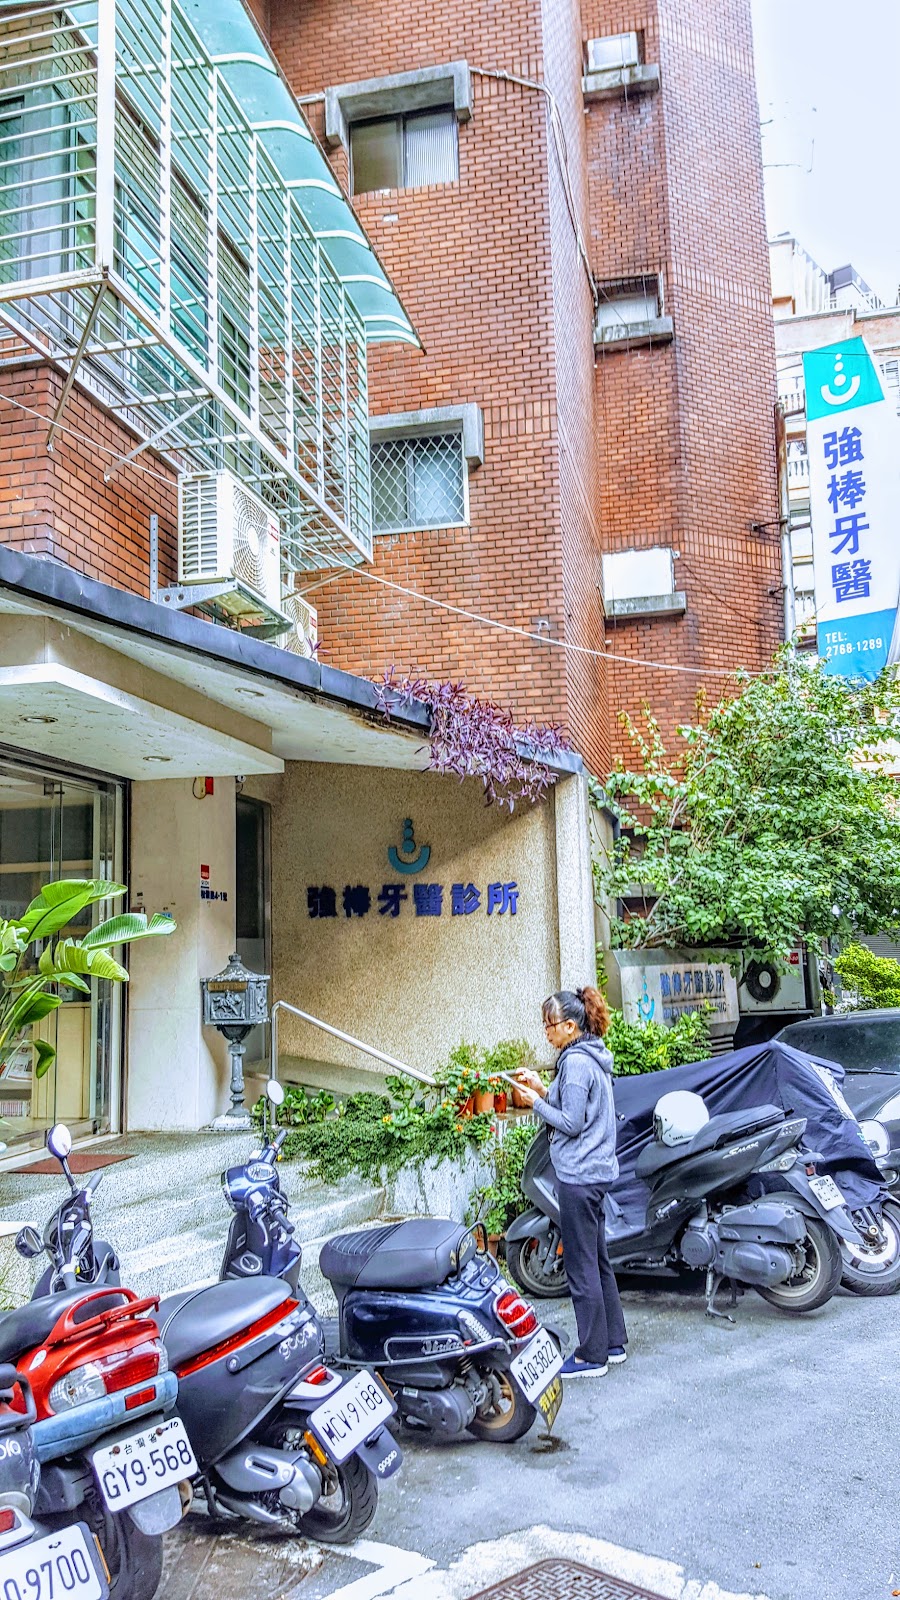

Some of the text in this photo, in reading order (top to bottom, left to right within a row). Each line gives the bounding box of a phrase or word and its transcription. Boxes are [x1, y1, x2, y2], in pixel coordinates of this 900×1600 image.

[822, 426, 872, 603] 強棒牙醫
[825, 631, 848, 644] TEL:
[825, 637, 883, 659] 2768-1289
[306, 881, 520, 918] 強棒牙醫診所
